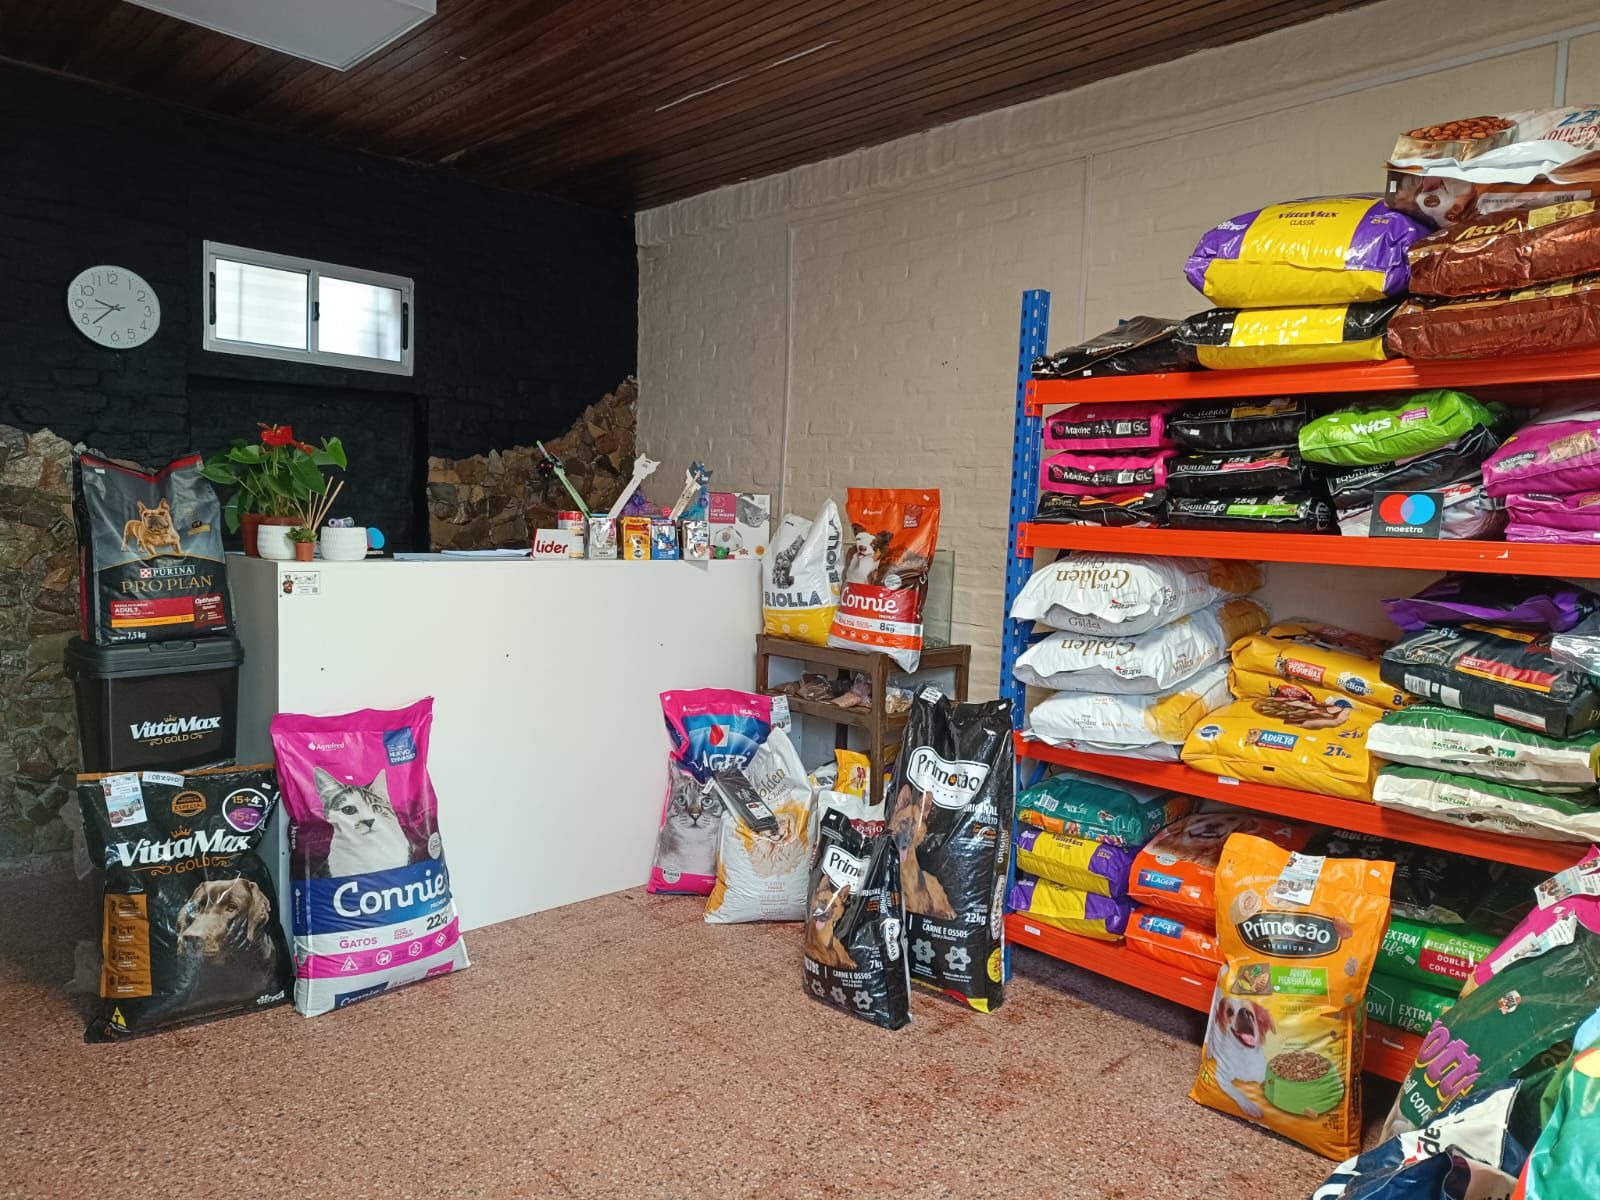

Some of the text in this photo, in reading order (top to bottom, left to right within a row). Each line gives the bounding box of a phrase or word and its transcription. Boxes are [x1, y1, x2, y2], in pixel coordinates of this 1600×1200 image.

[92, 272, 100, 287] 11
[107, 273, 118, 285] 12
[81, 285, 94, 296] 10
[137, 290, 146, 302] 2
[75, 299, 84, 309] 9
[144, 306, 151, 317] 3
[82, 313, 89, 325] 8
[140, 320, 147, 330] 4
[95, 326, 103, 336] 7
[111, 331, 120, 342] 6
[127, 328, 136, 339] 5
[1065, 425, 1091, 434] Maxine
[1133, 420, 1149, 432] GC
[1135, 468, 1153, 481] GC
[1385, 525, 1424, 534] maestro
[153, 565, 194, 577] PURINA
[120, 575, 214, 594] PRO PLAN
[1056, 569, 1131, 590] Golden
[841, 588, 900, 614] Connie
[129, 716, 222, 740] VittaMax
[163, 734, 189, 744] GOLD
[1261, 733, 1296, 746] ADULTO
[758, 767, 787, 799] olden
[115, 829, 252, 868] VittaMax
[174, 856, 212, 874] GOLD
[1150, 874, 1177, 887] LAGER
[333, 869, 446, 918] Connie
[964, 911, 987, 926] 22kg
[922, 923, 942, 935] CARNE
[947, 928, 969, 938] OSSOS
[1242, 918, 1332, 944] Primocão
[339, 936, 378, 950] GATOS
[1381, 939, 1406, 957] life
[1449, 938, 1491, 955] CACHOR
[1437, 954, 1467, 968] DOBLE
[1429, 963, 1448, 975] CON
[1366, 1000, 1387, 1017] OW
[1398, 1004, 1433, 1024] EXTRA
